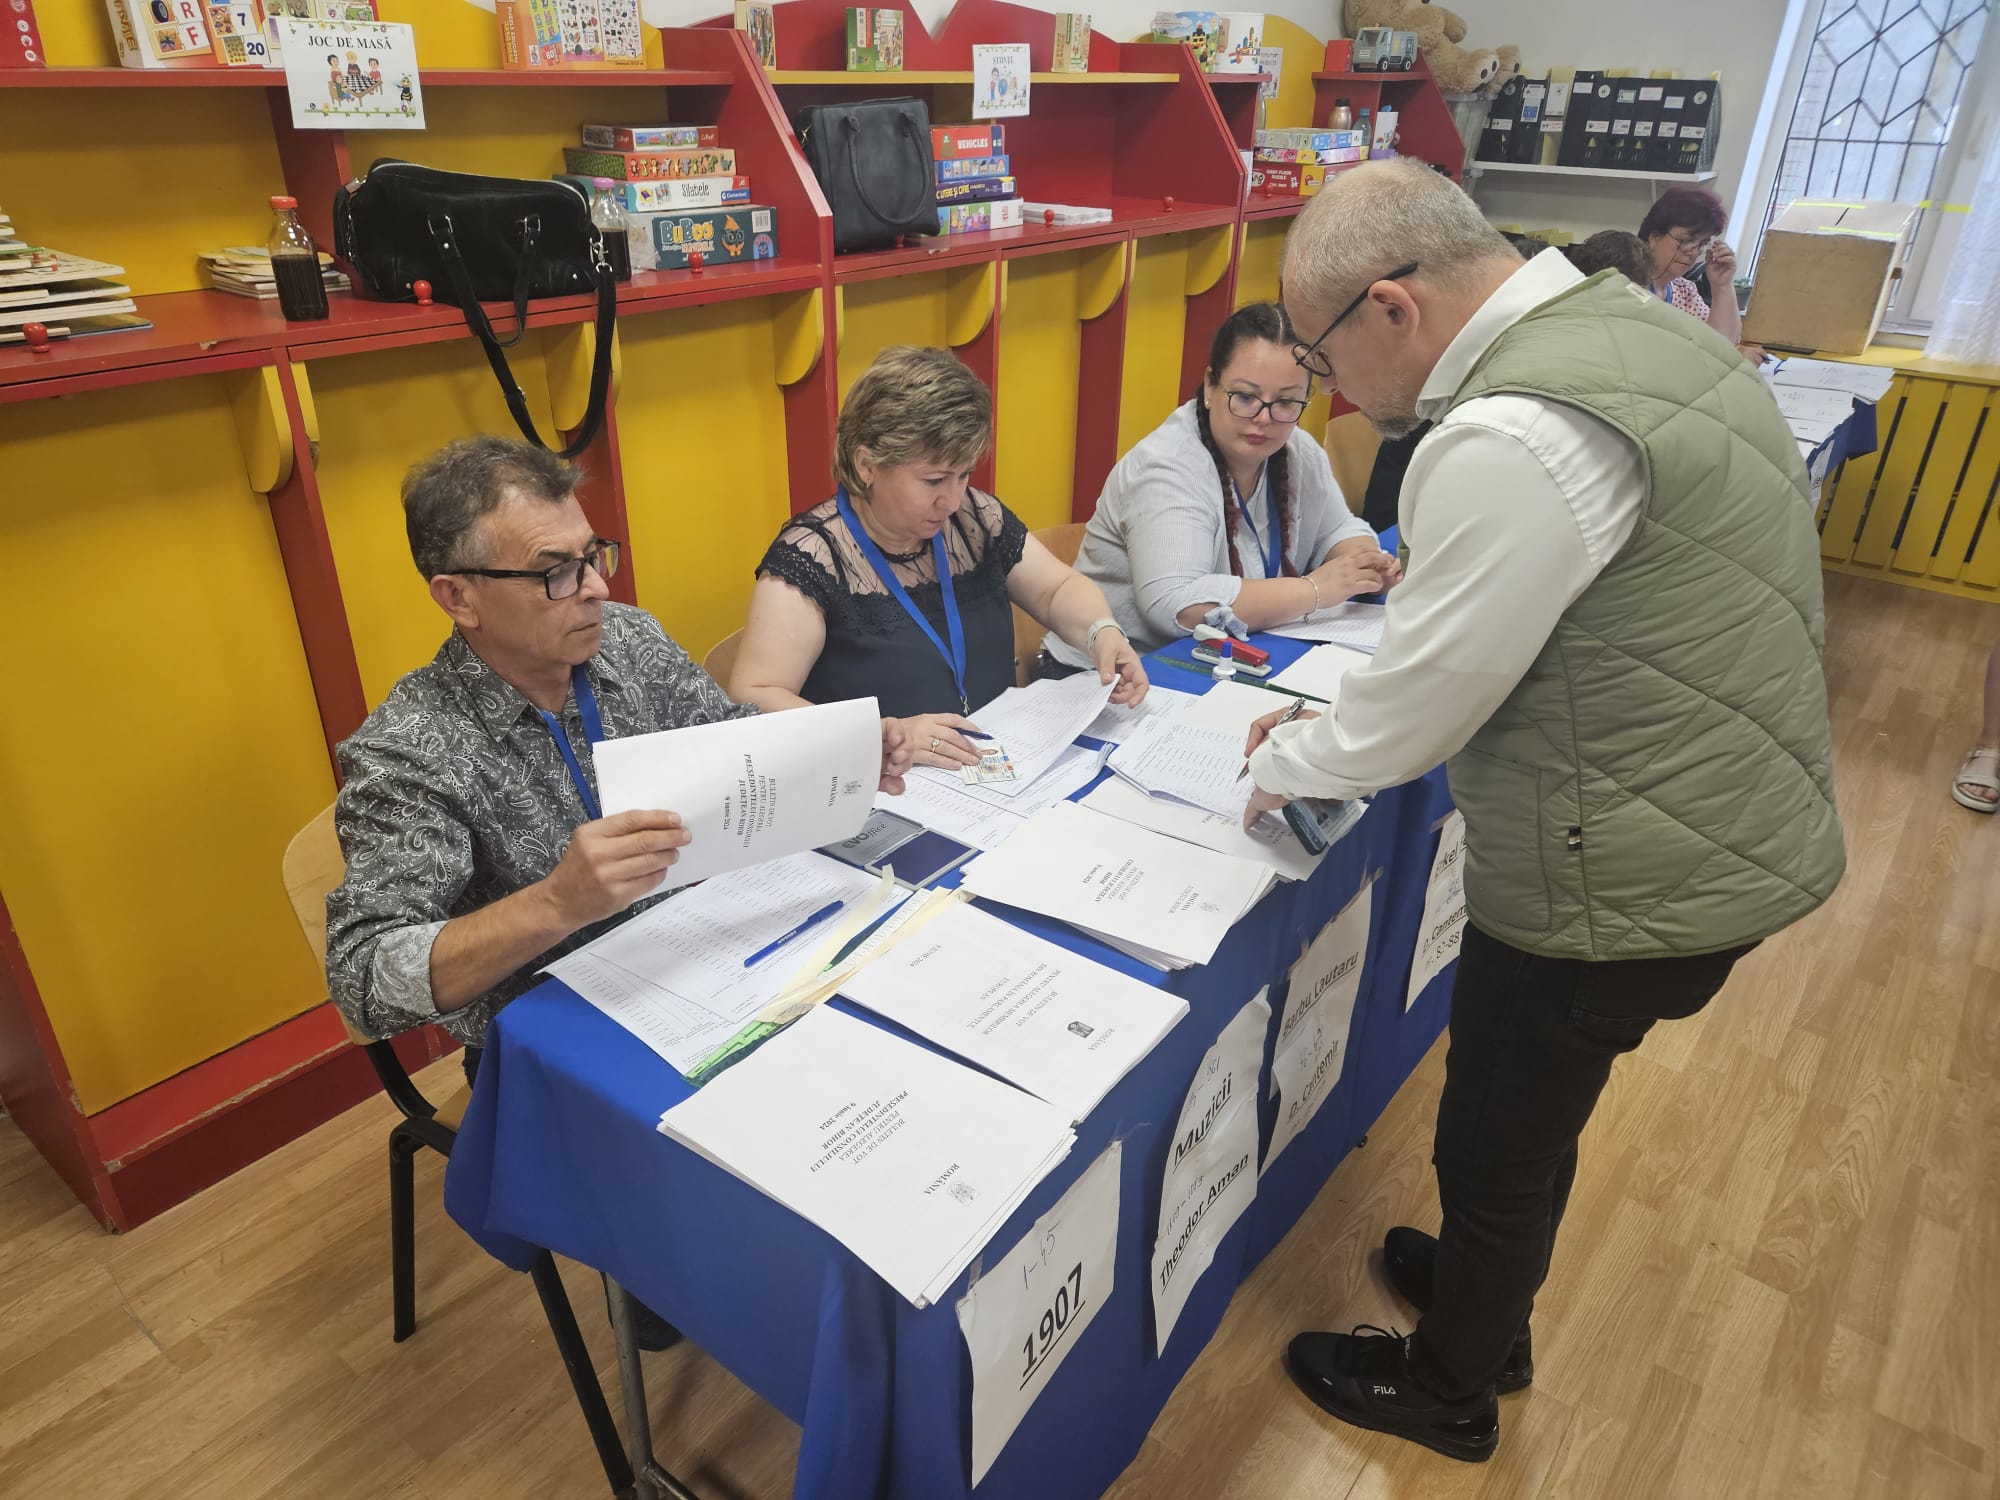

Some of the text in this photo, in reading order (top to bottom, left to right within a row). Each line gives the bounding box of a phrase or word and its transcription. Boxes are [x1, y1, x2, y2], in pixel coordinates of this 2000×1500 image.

[180, 1, 195, 18] R
[237, 12, 247, 26] 7
[187, 26, 201, 47] F
[308, 36, 392, 49] JOC DE MASĂ
[246, 41, 265, 56] 20
[957, 138, 988, 149] VEHICLES
[682, 183, 710, 197] Silabele
[1283, 952, 1359, 1036] Barbu Lautaru
[1303, 1040, 1338, 1102] Cantemir
[819, 1117, 835, 1131] 2024
[1175, 1072, 1231, 1166] Muzicii
[821, 1128, 845, 1150] BIHOR
[838, 1109, 899, 1162] PENTRU ALEGEREA
[851, 1117, 904, 1164] BULETIN DE VOT
[809, 1132, 856, 1172] CONSILIULUI
[923, 1163, 959, 1195] ROMÂNIA
[1160, 1154, 1248, 1287] Theodor Aman
[1022, 1261, 1083, 1378] 1907
[1373, 1385, 1397, 1395] FILA
